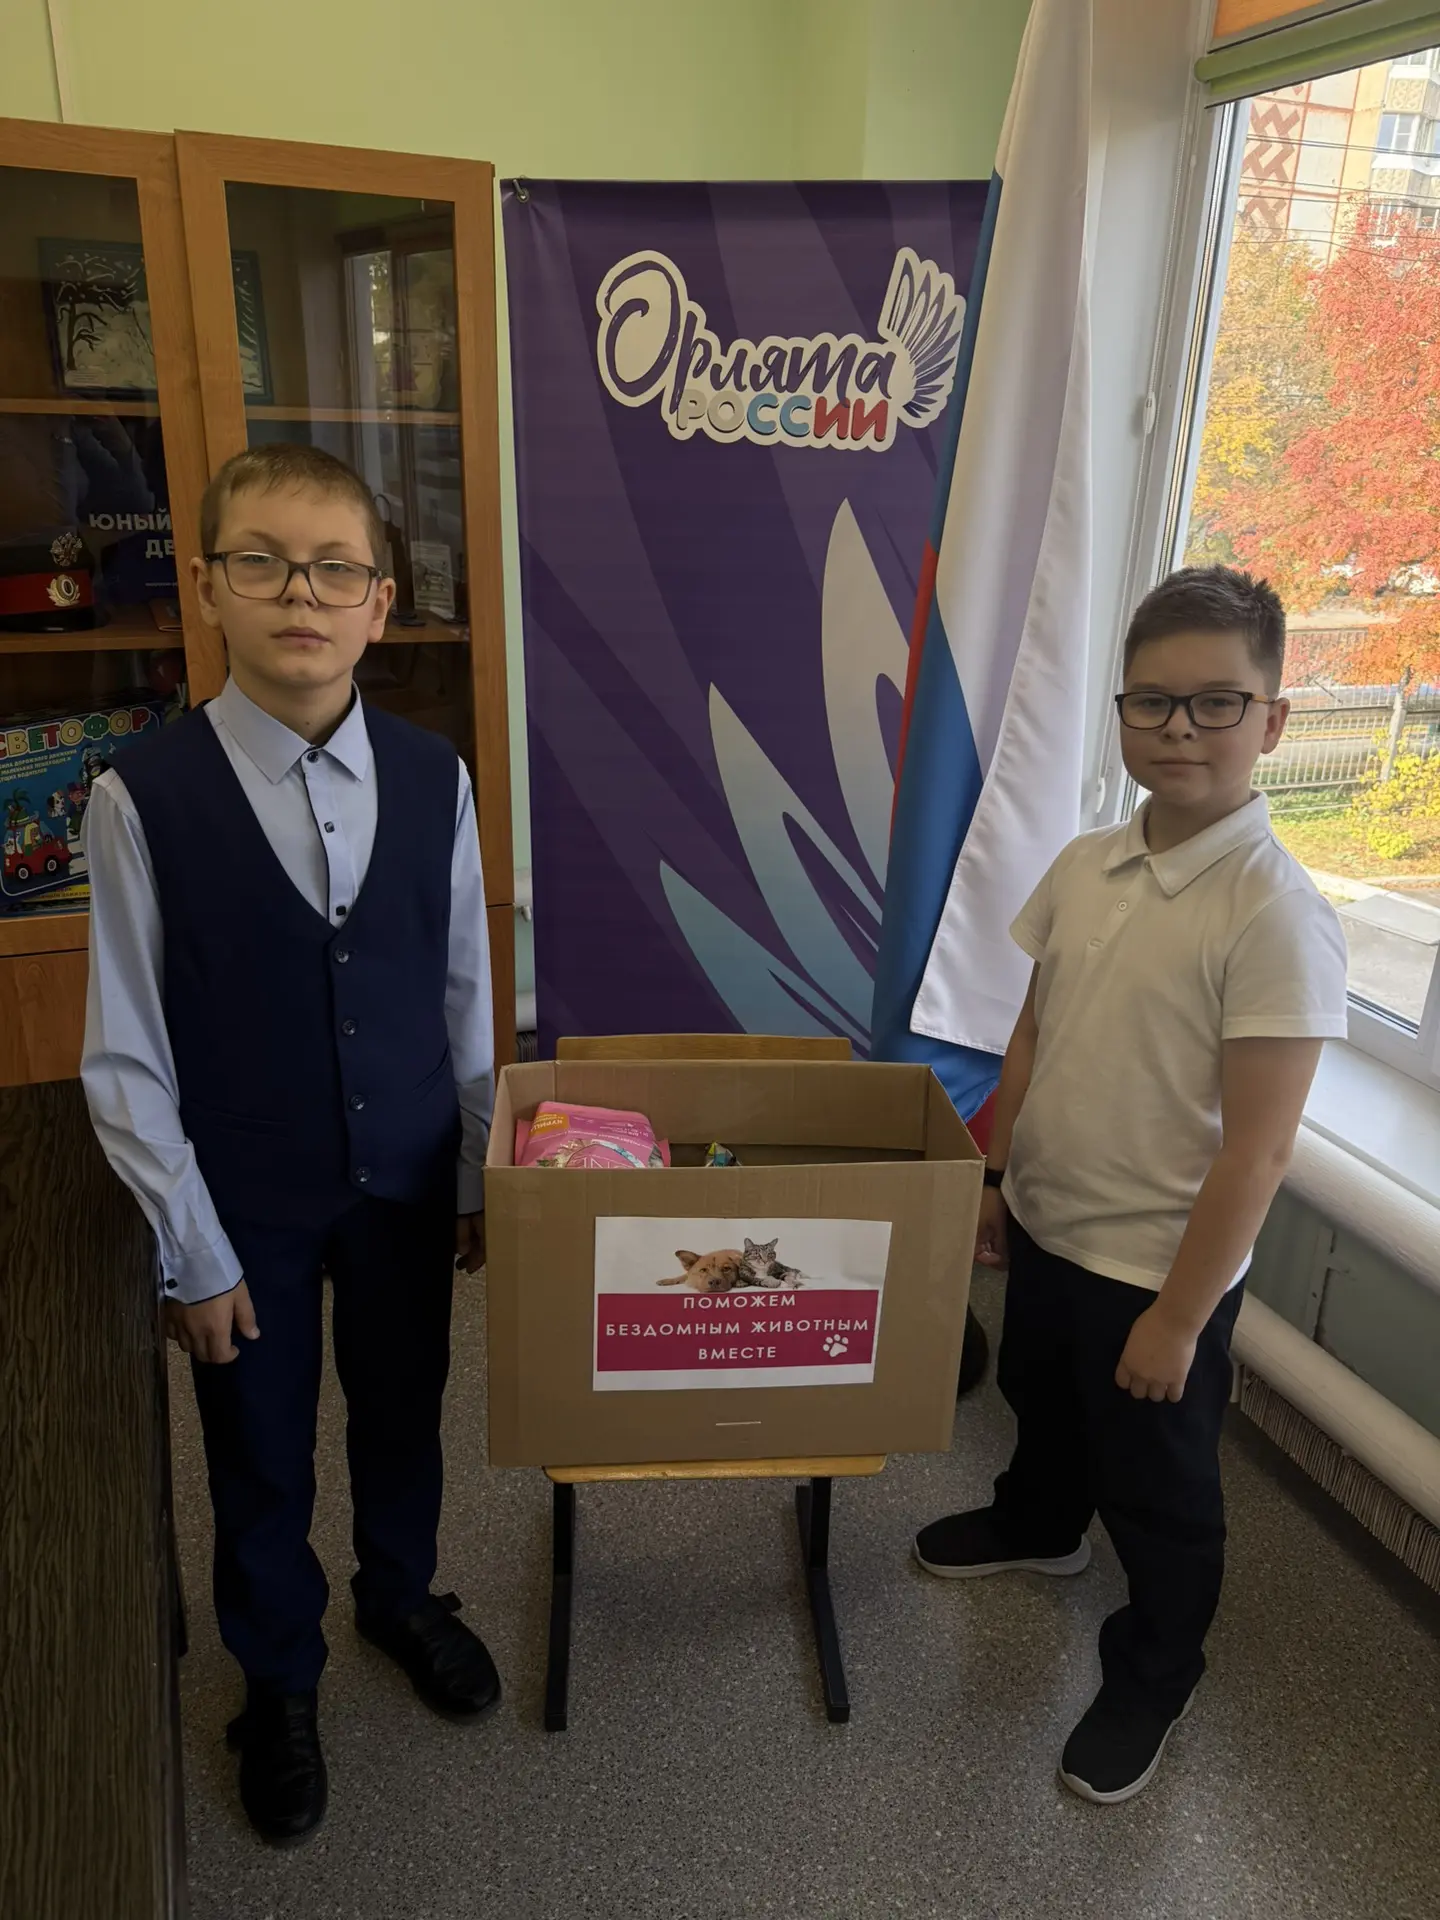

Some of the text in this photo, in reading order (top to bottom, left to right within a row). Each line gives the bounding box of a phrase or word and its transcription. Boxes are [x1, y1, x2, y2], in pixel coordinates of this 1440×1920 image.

[604, 260, 896, 414] Орлята
[676, 389, 889, 442] РОССИИ
[89, 508, 172, 531] ЮНЫЙ
[683, 1294, 796, 1309] ПОМОЖЕМ
[605, 1318, 869, 1338] БЕЗДОМНЫМ ЖИВОТНЫМ
[698, 1346, 777, 1360] ВМЕСТЕ
